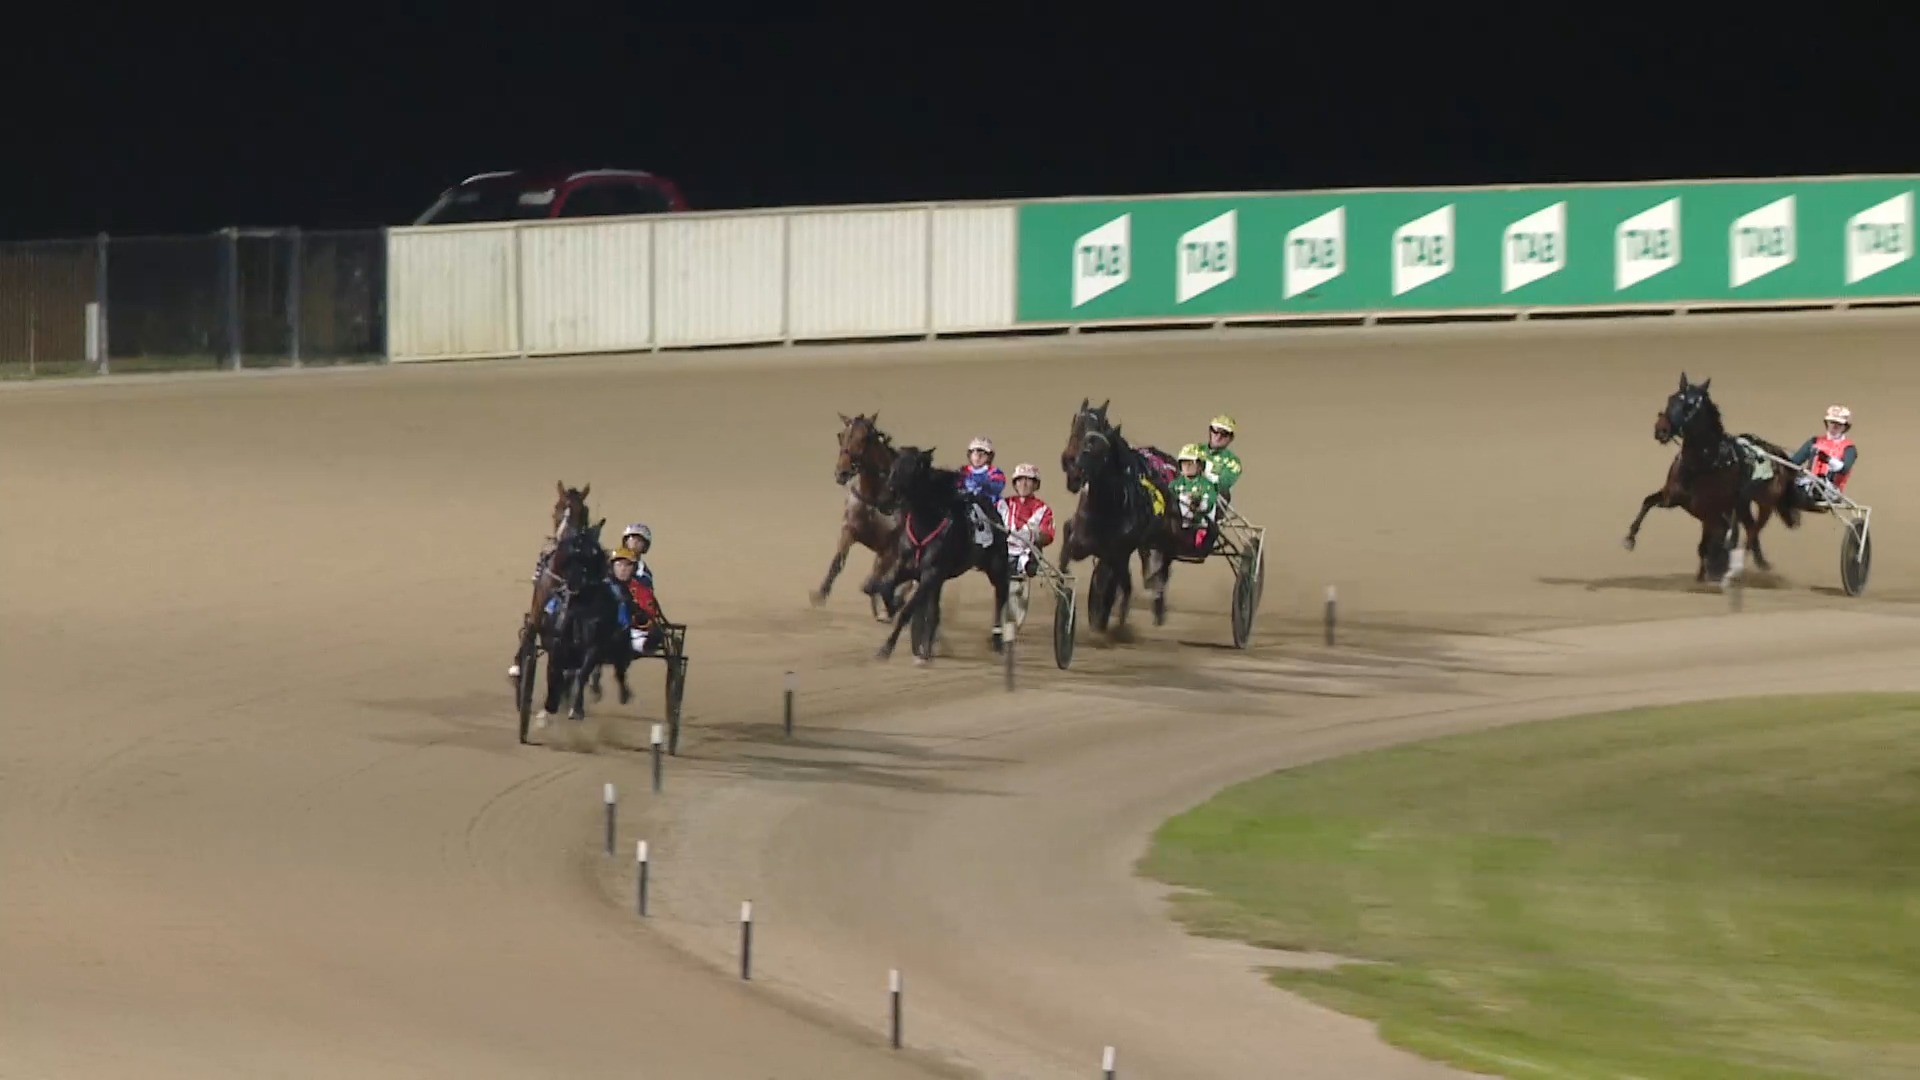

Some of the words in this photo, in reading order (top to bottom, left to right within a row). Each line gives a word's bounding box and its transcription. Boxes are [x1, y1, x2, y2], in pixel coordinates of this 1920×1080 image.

[1289, 237, 1336, 269] TAB
[1397, 235, 1445, 266] TAB
[1512, 231, 1556, 263] TAB
[1626, 228, 1671, 261] TAB
[1741, 226, 1790, 257] TAB
[1857, 223, 1906, 254] TAB
[1078, 245, 1122, 277] TAB
[1183, 241, 1228, 273] TAB
